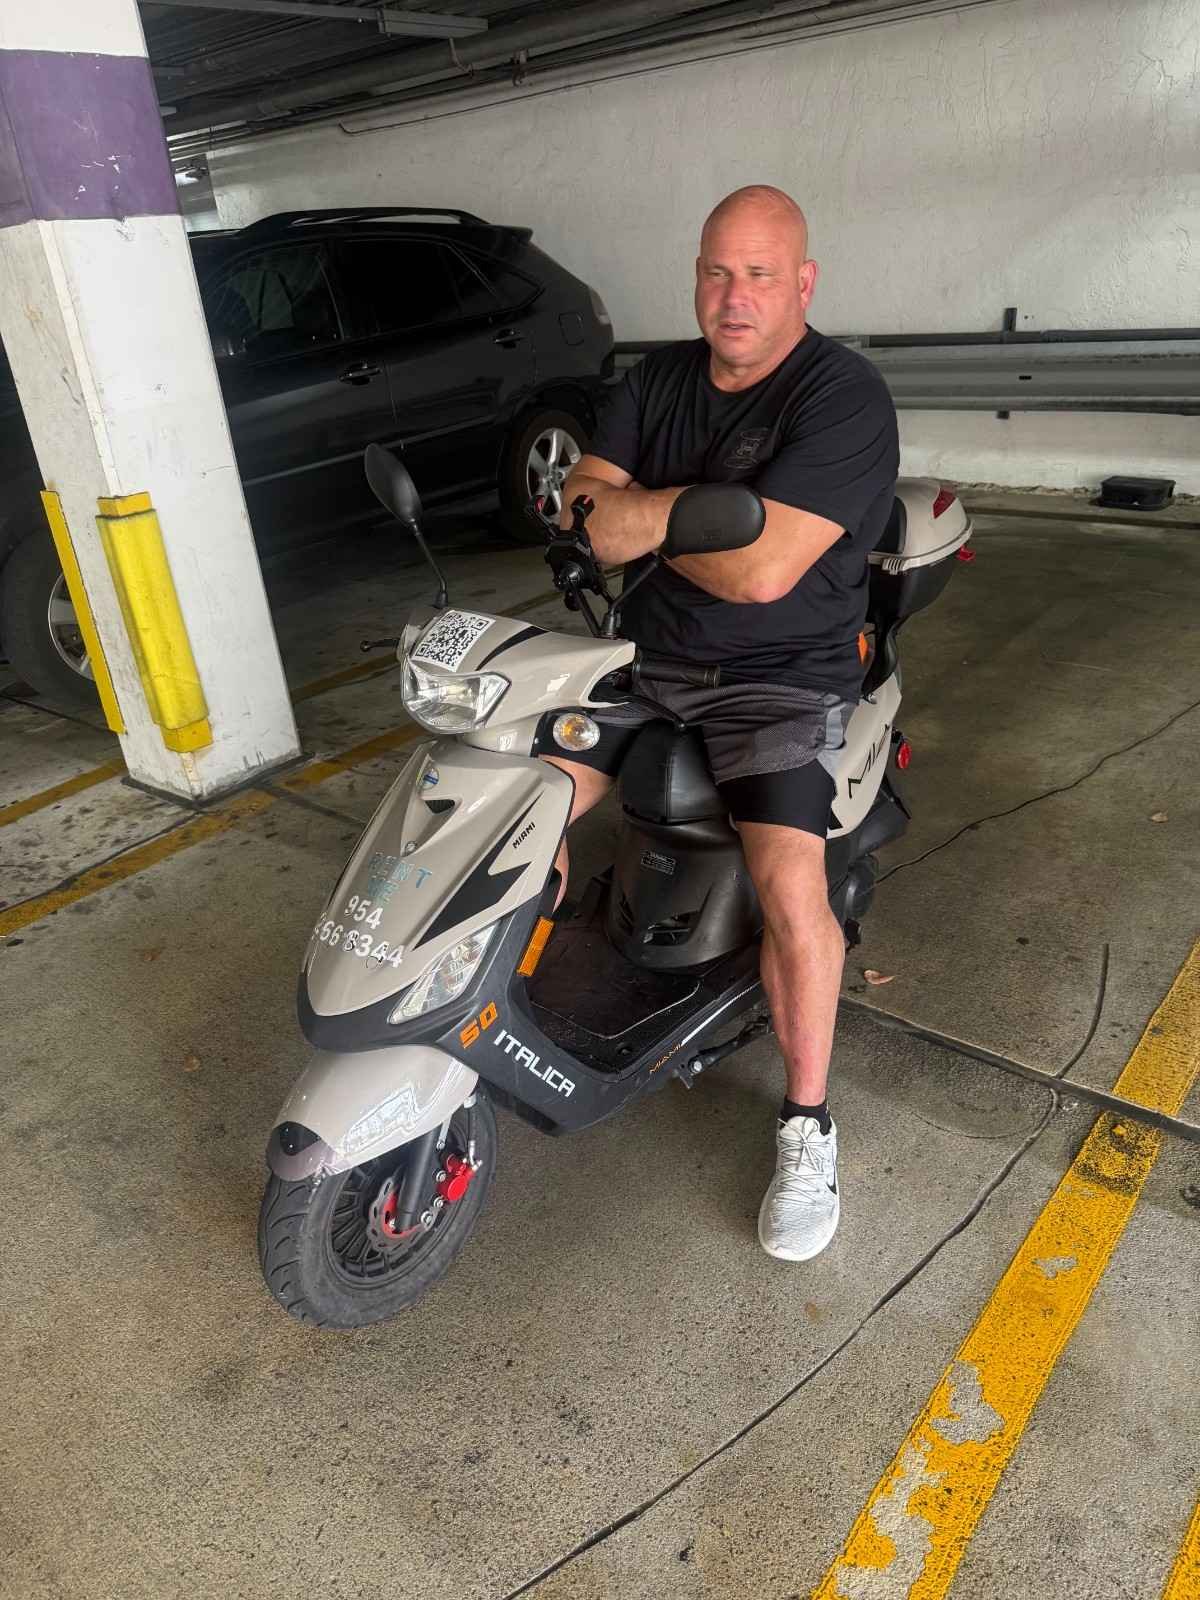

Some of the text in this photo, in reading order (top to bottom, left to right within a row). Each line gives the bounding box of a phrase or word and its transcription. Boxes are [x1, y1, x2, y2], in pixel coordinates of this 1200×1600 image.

[512, 821, 536, 849] MIAMI
[344, 895, 384, 930] 954
[342, 929, 405, 969] 8344
[460, 1001, 498, 1049] 50
[493, 1029, 576, 1098] ITALICA
